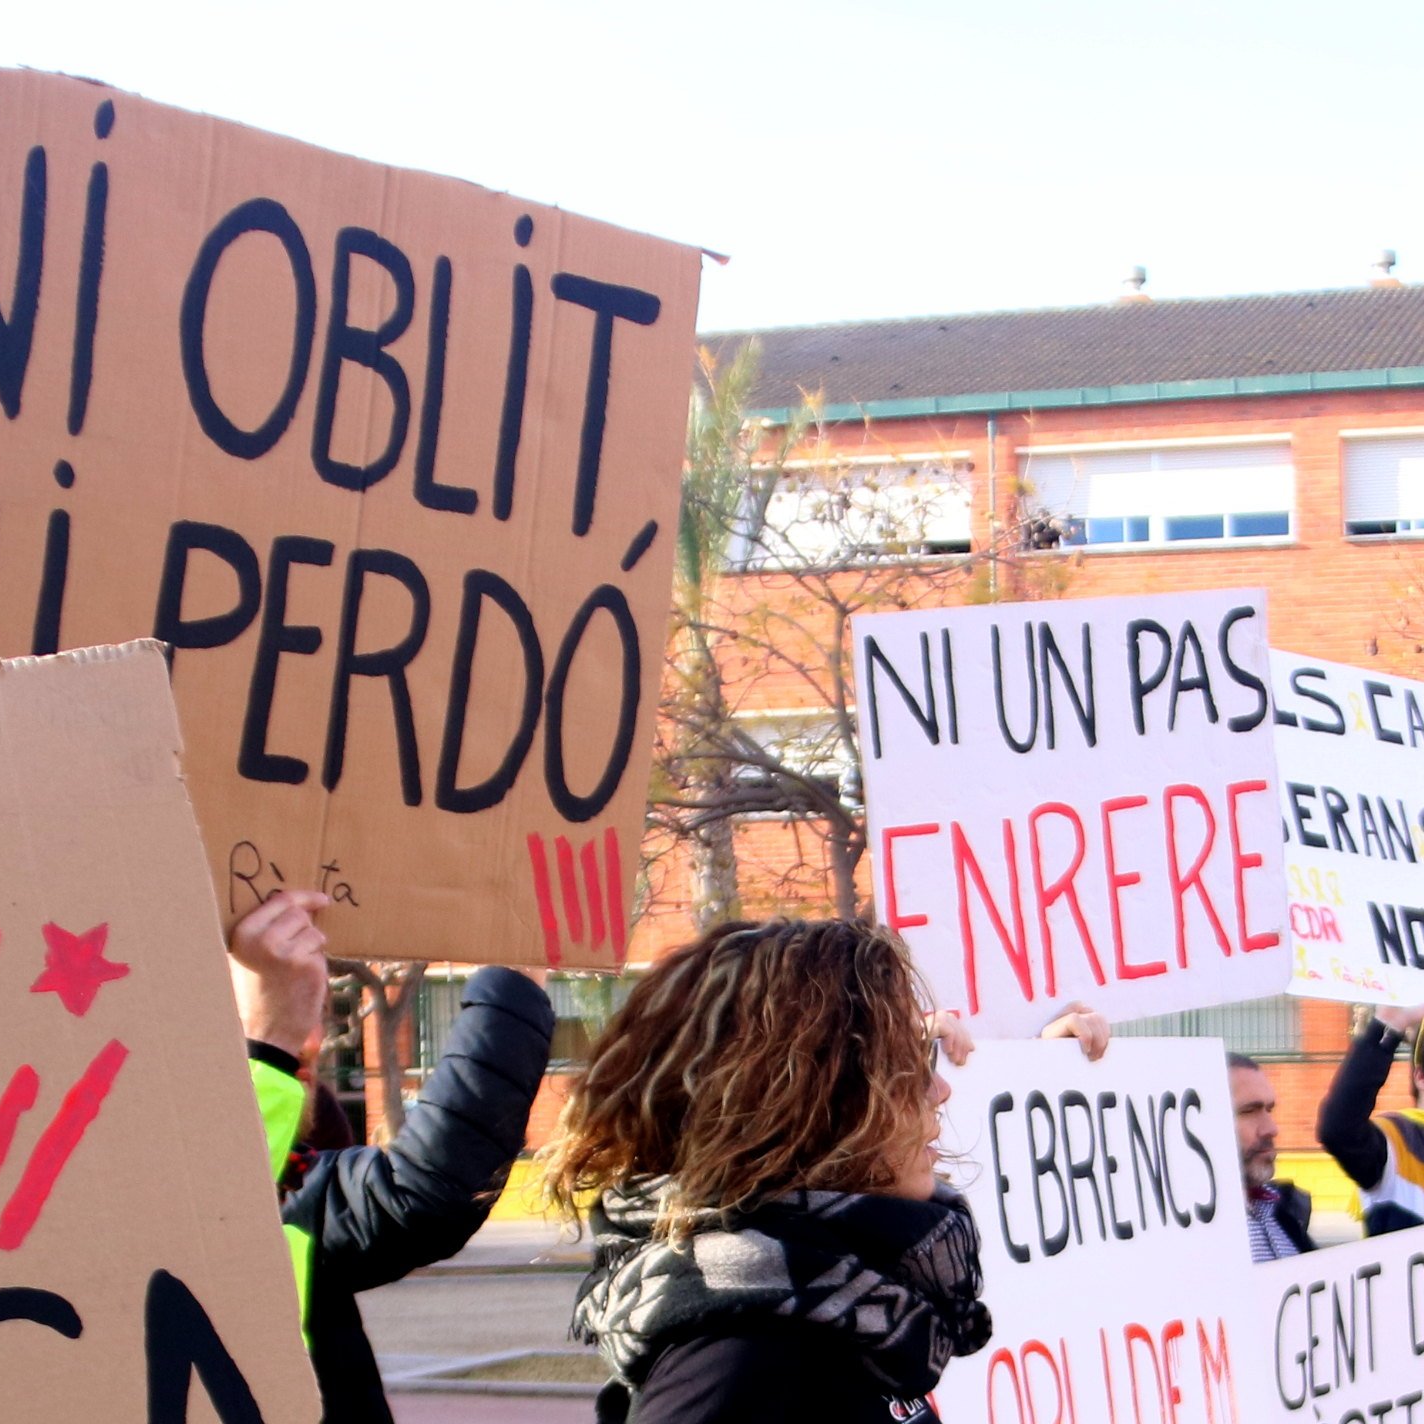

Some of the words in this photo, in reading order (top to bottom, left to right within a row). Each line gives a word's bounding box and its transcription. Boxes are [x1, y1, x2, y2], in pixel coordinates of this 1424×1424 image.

[153, 517, 659, 824] PERDÓ
[864, 627, 962, 759] NI
[991, 620, 1098, 755] UN
[1126, 605, 1268, 737] PAS
[229, 841, 359, 914] Ràta
[882, 779, 1280, 1018] ENRERE
[1283, 781, 1418, 863] ERAN
[989, 1088, 1217, 1264] EBRENCS
[1274, 1262, 1382, 1411] GENT
